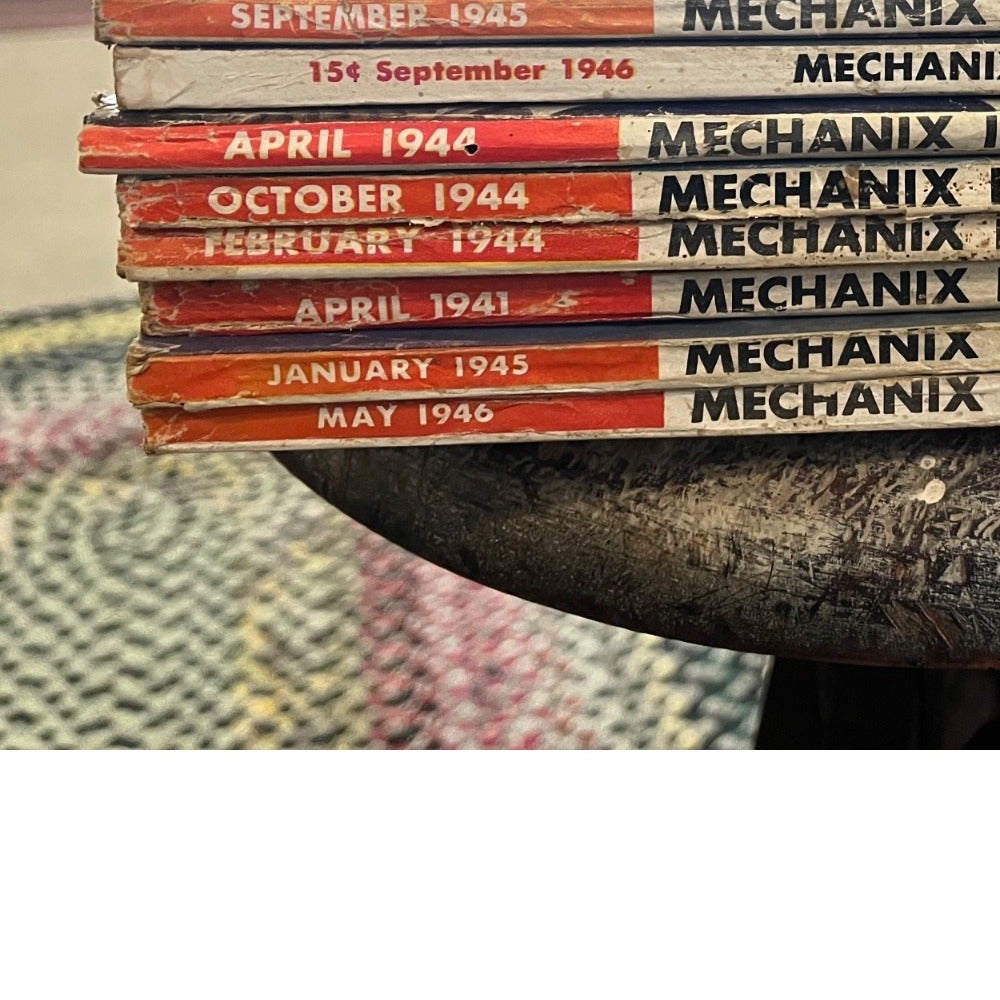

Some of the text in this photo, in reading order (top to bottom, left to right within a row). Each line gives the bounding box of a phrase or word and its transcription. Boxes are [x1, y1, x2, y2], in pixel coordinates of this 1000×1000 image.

[231, 2, 528, 32] SEPTEMBER 1945
[309, 58, 635, 87] 15¢ September 1946
[224, 126, 478, 161] APRIL 1944
[647, 114, 954, 159] MECHANIX
[207, 182, 530, 216] OCTOBER 1944
[659, 167, 963, 215] MECHANIX
[203, 225, 545, 257] FEBRUARY 1944
[668, 217, 967, 258] MECHANIX
[294, 291, 509, 326] APRIL 1941
[678, 268, 969, 314] MECHANIX
[685, 330, 979, 375] MECHANIX
[267, 354, 529, 388] JANUARY 1945
[317, 402, 494, 429] MAY 1946
[690, 375, 983, 423] MECHANIX
